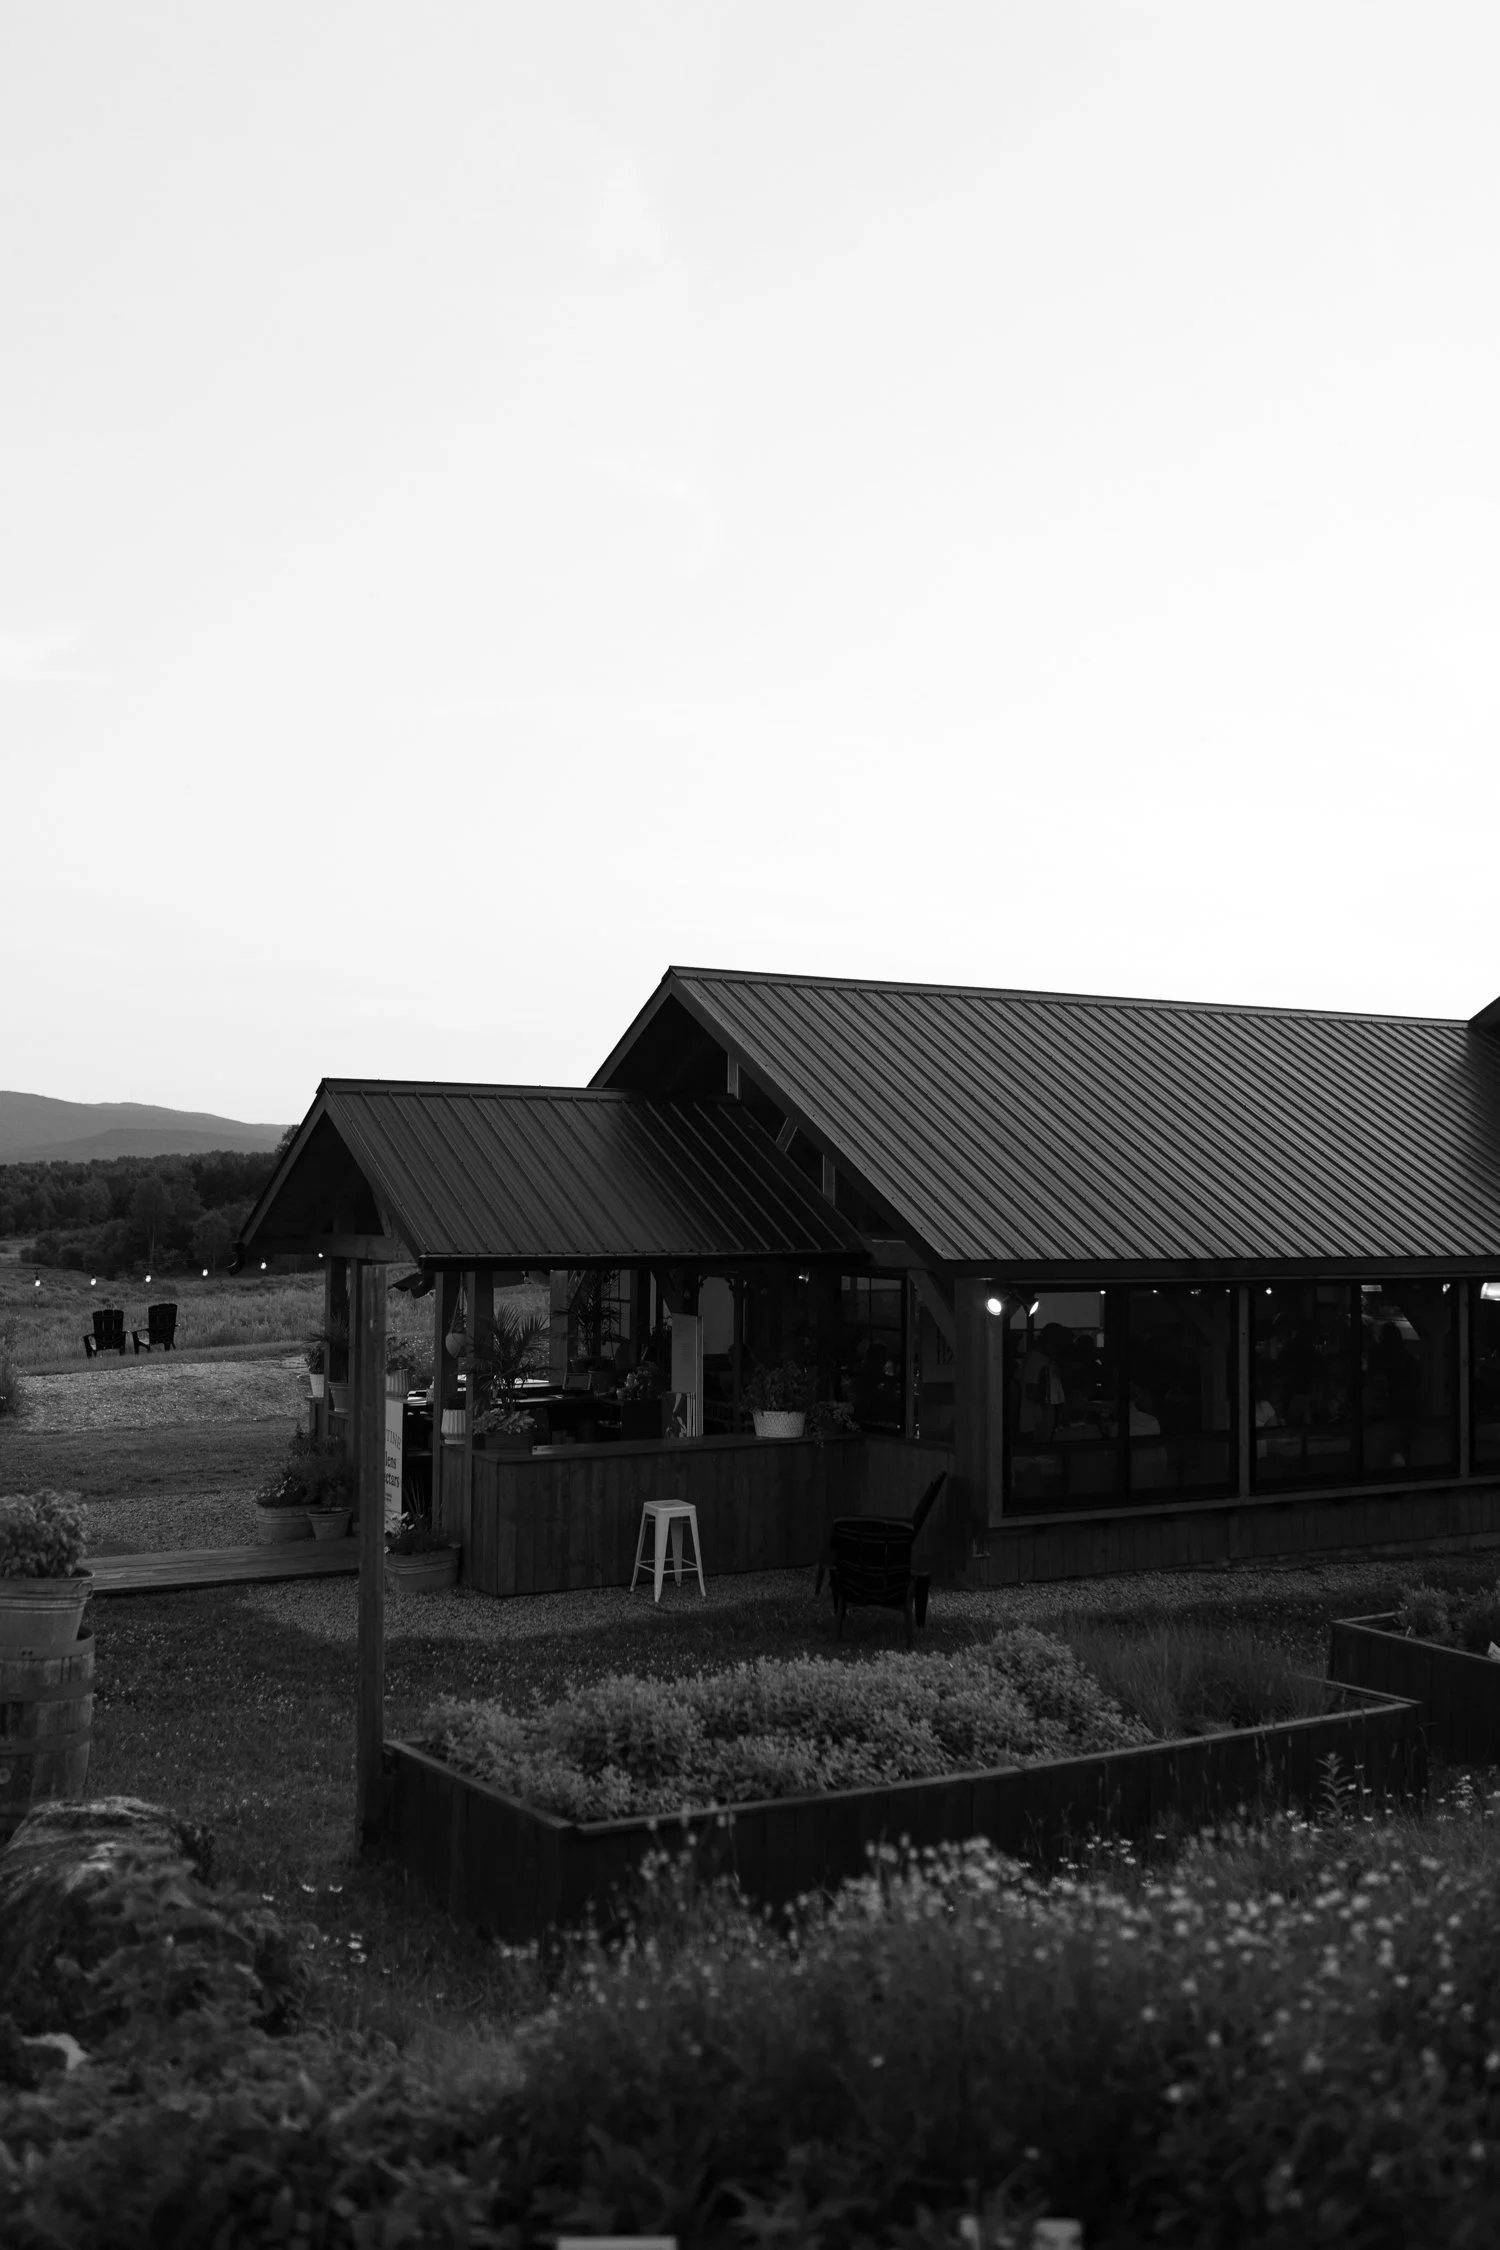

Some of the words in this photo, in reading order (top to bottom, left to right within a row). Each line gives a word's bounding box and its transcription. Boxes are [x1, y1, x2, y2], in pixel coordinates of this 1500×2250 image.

[385, 1428, 401, 1450] TINE
[385, 1450, 396, 1469] lens
[385, 1473, 400, 1488] ctars
